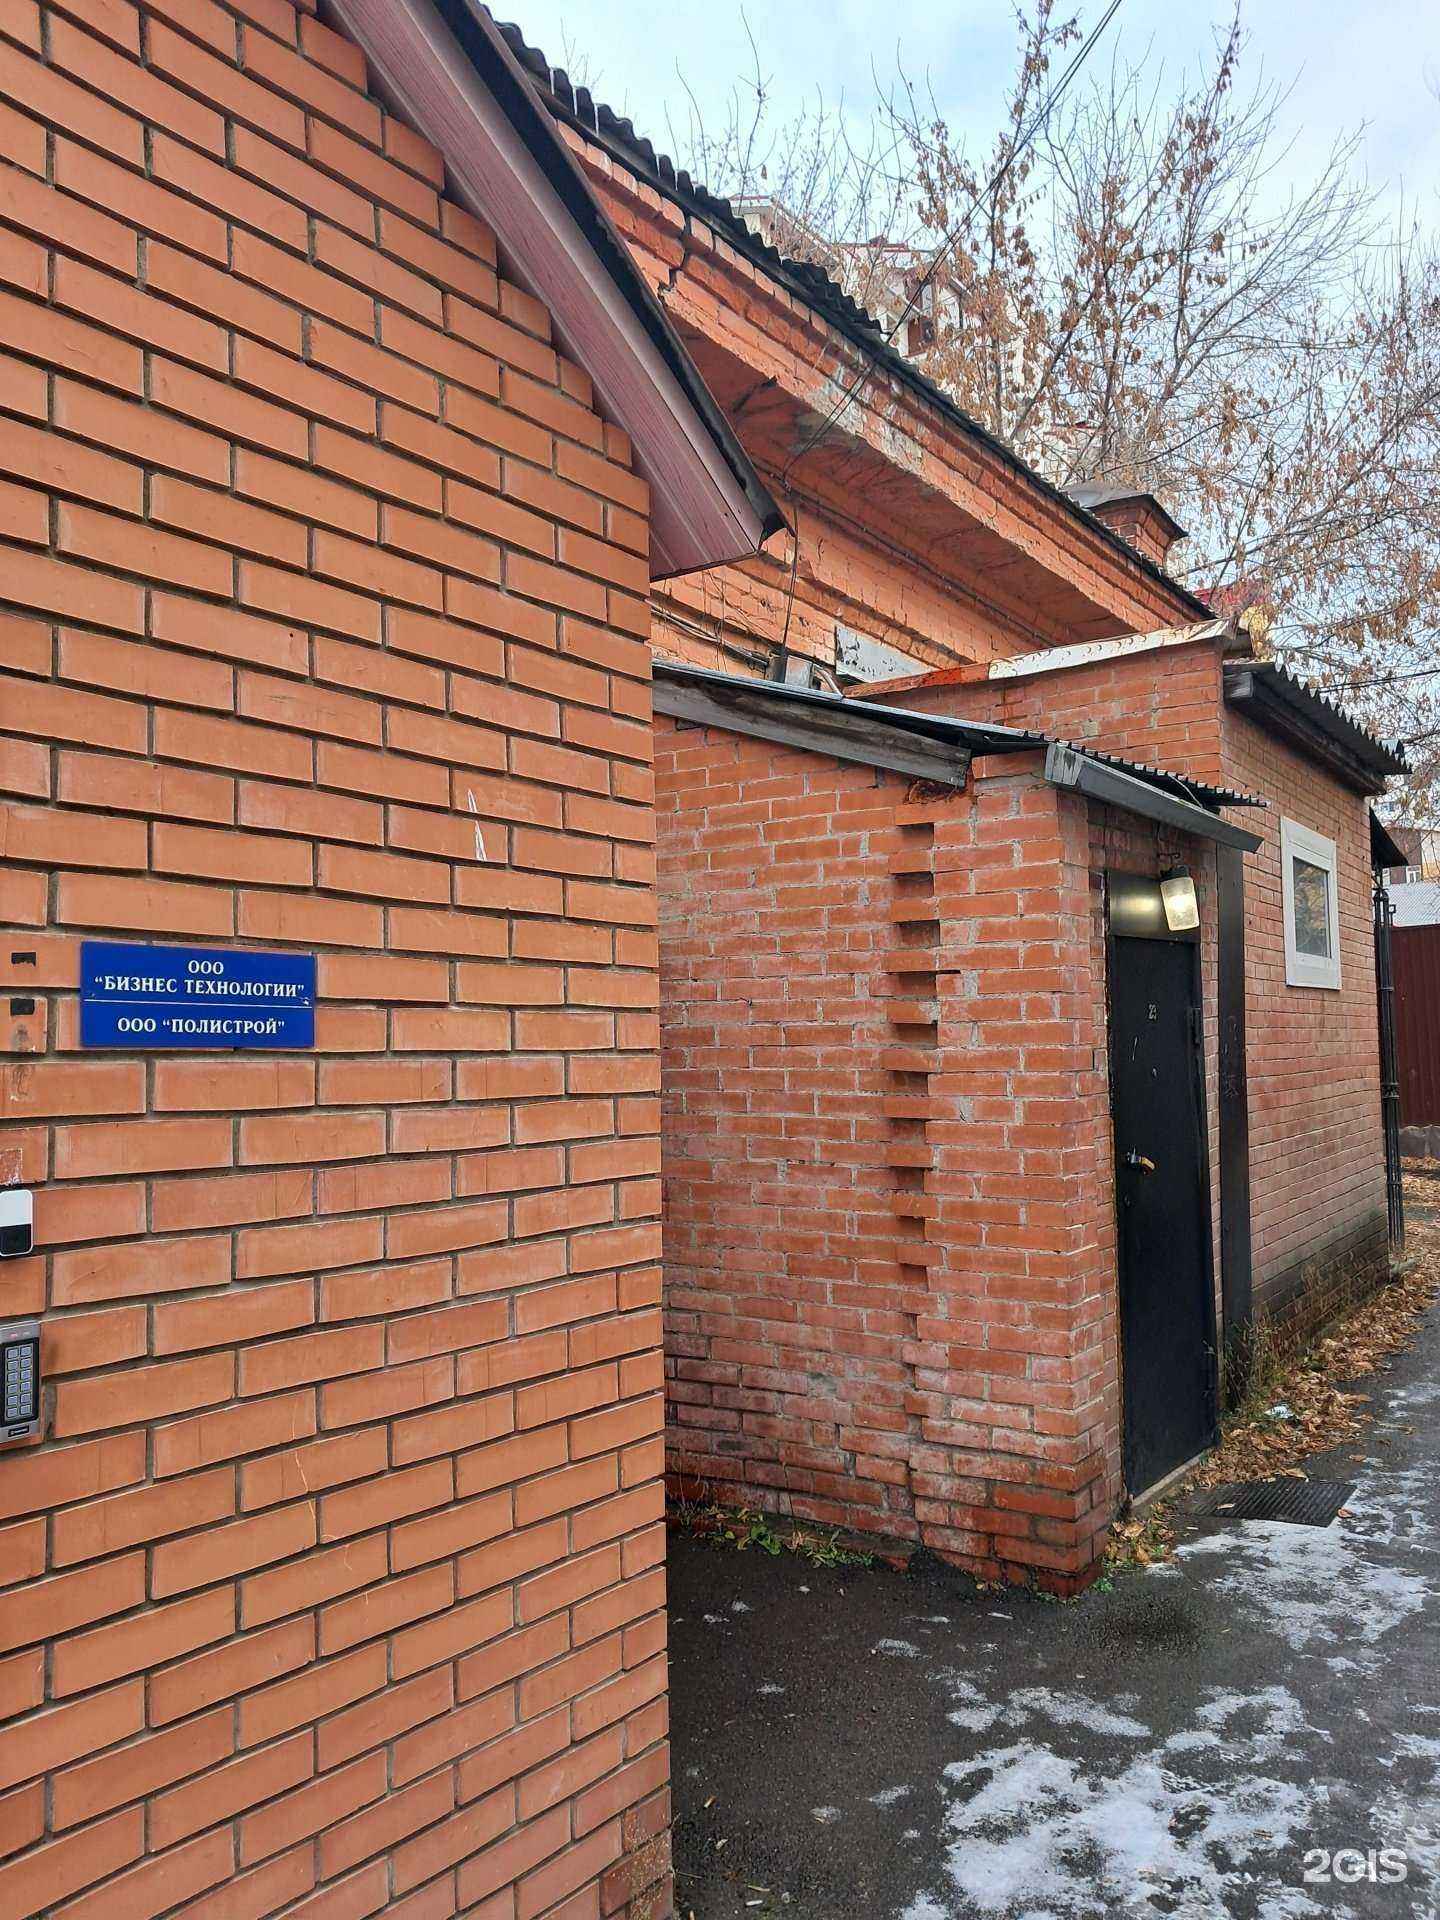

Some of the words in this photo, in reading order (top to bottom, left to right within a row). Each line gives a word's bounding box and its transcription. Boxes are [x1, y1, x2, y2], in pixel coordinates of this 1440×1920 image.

[187, 959, 224, 975] ООО
[94, 975, 178, 993] “БИЗНЕС
[184, 978, 305, 997] ТЕХНОЛОГИИ”
[117, 1017, 157, 1033] ООО
[162, 1017, 285, 1034] “ПОЛИСТРОЙ”
